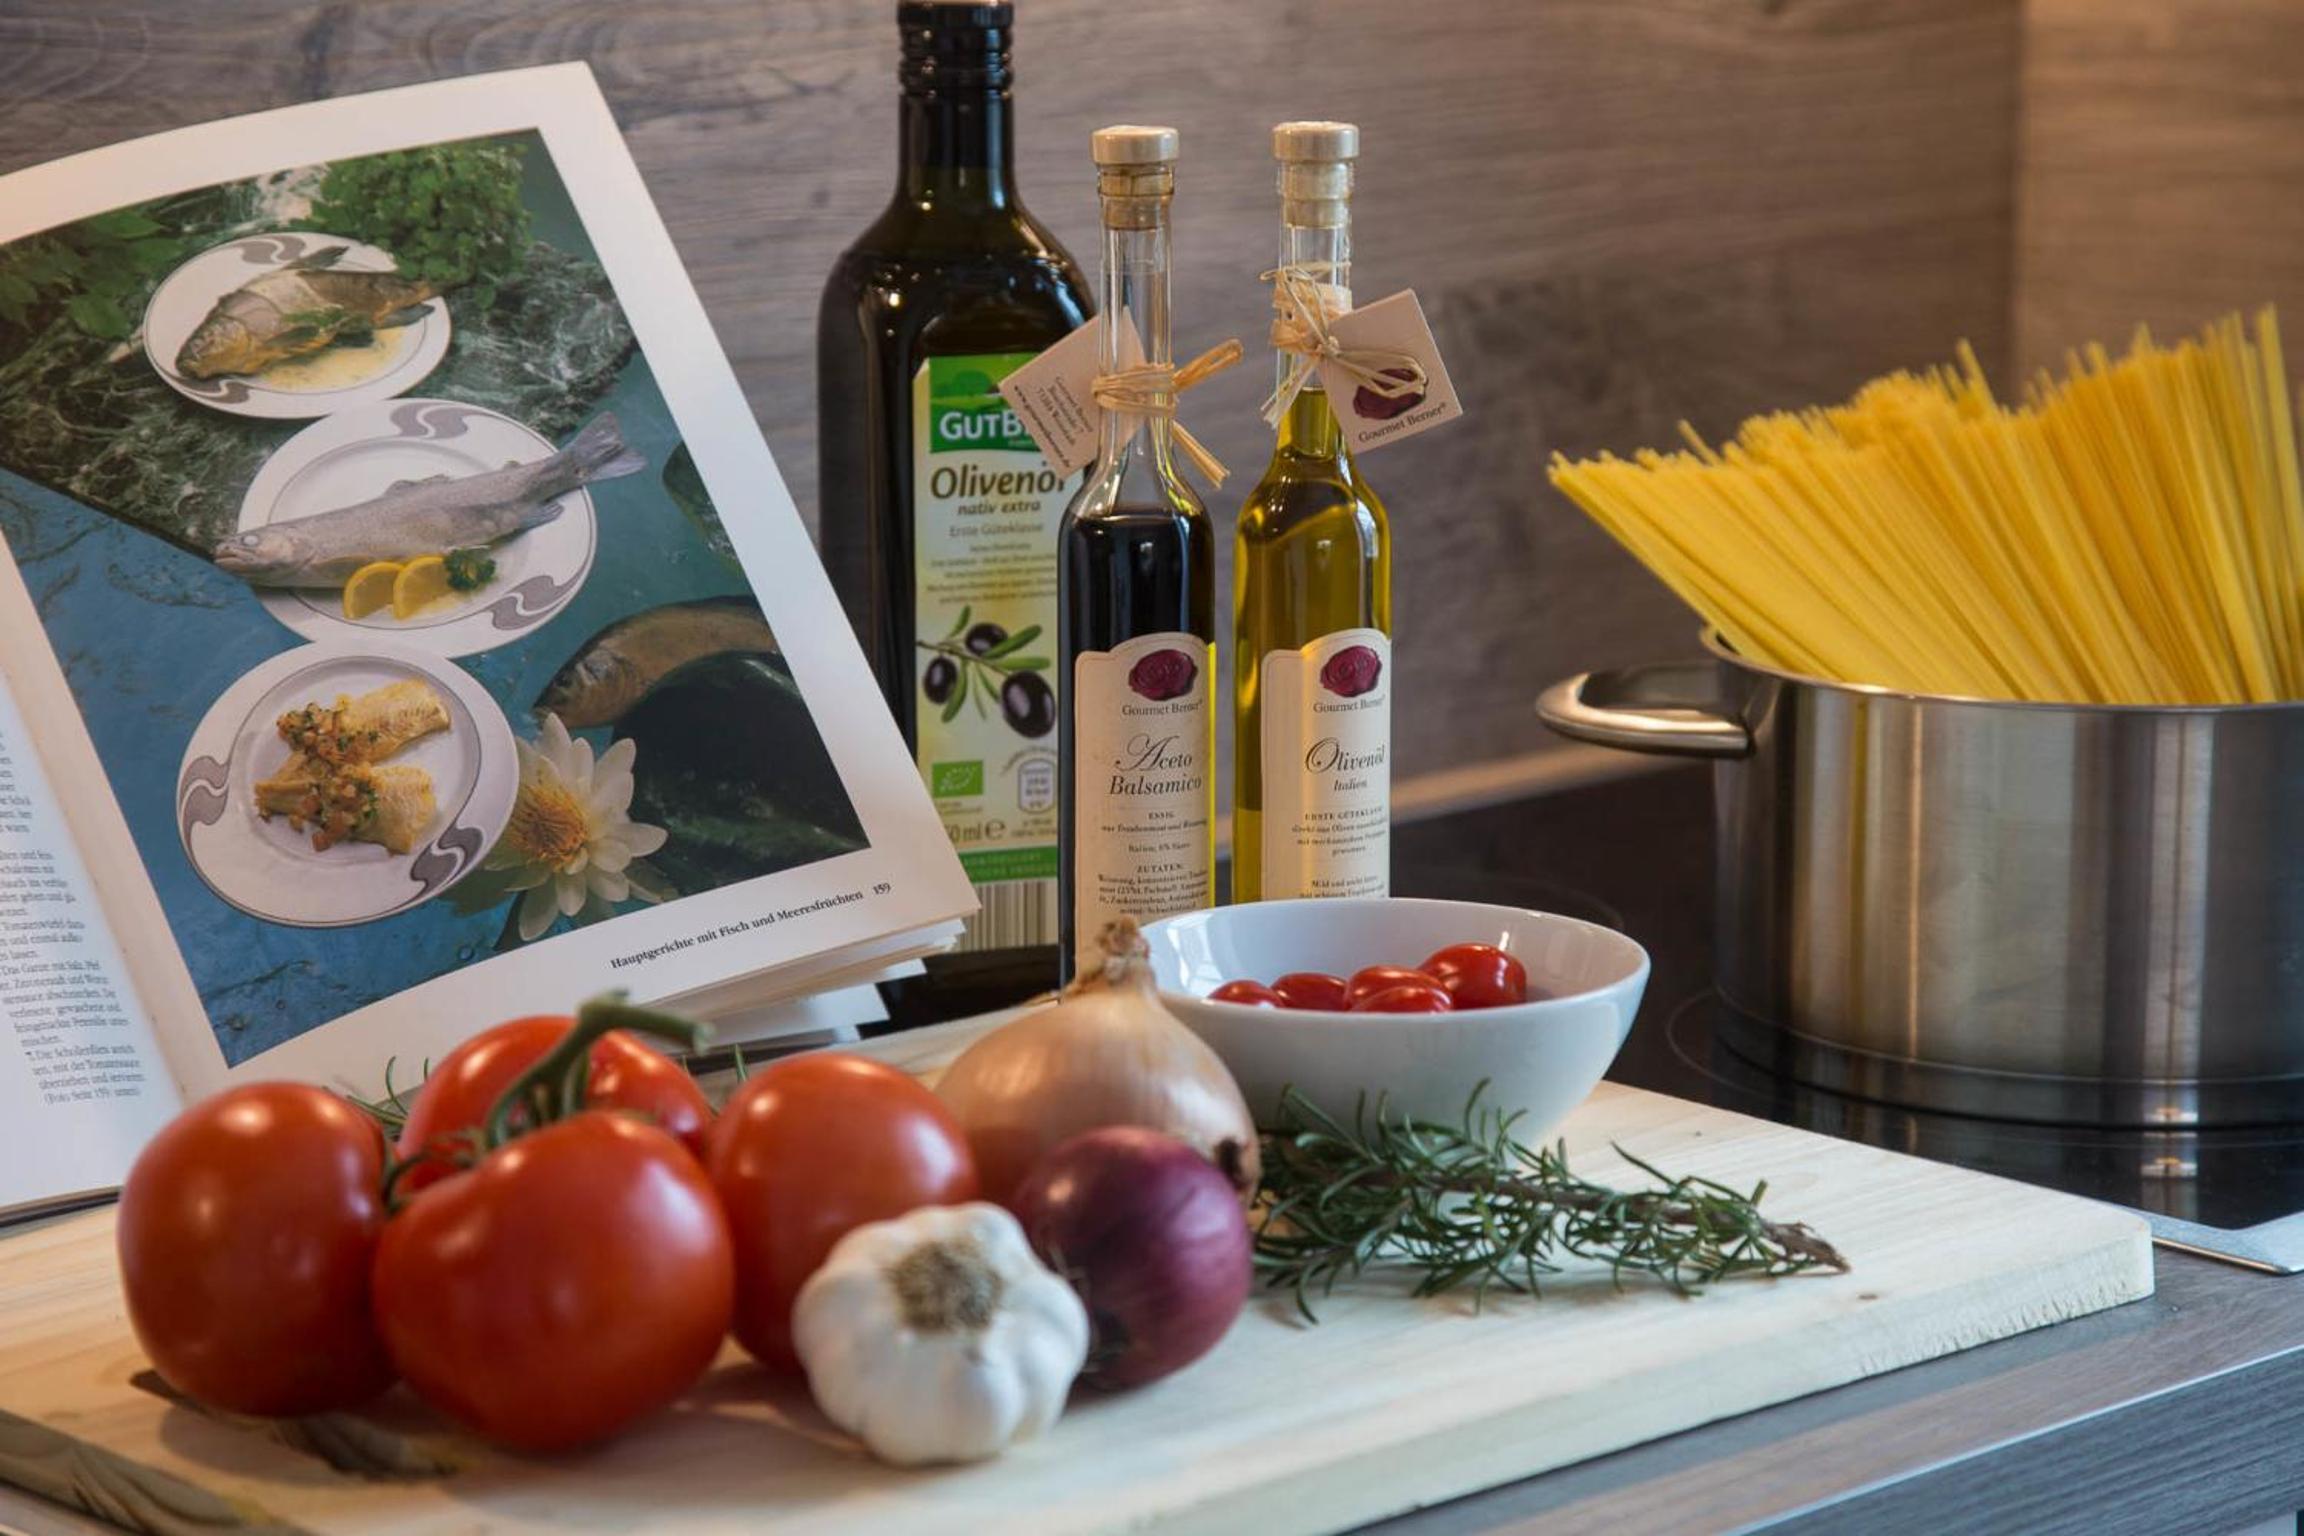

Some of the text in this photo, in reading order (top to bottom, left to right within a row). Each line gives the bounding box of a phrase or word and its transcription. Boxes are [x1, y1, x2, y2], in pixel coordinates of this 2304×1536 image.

[939, 409, 1033, 441] GUTB
[1358, 421, 1405, 442] Gourmet
[958, 499, 1042, 516] nativ extra
[1121, 703, 1169, 716] Gourmet
[1312, 701, 1358, 713] Gourmet
[1113, 732, 1193, 772] Aceto
[1305, 736, 1385, 774] Olivenöl
[1108, 773, 1201, 796] Balsamico
[872, 882, 892, 896] 159
[610, 890, 865, 969] Hauptgerichte mit Fisch und Meeresfrüchten
